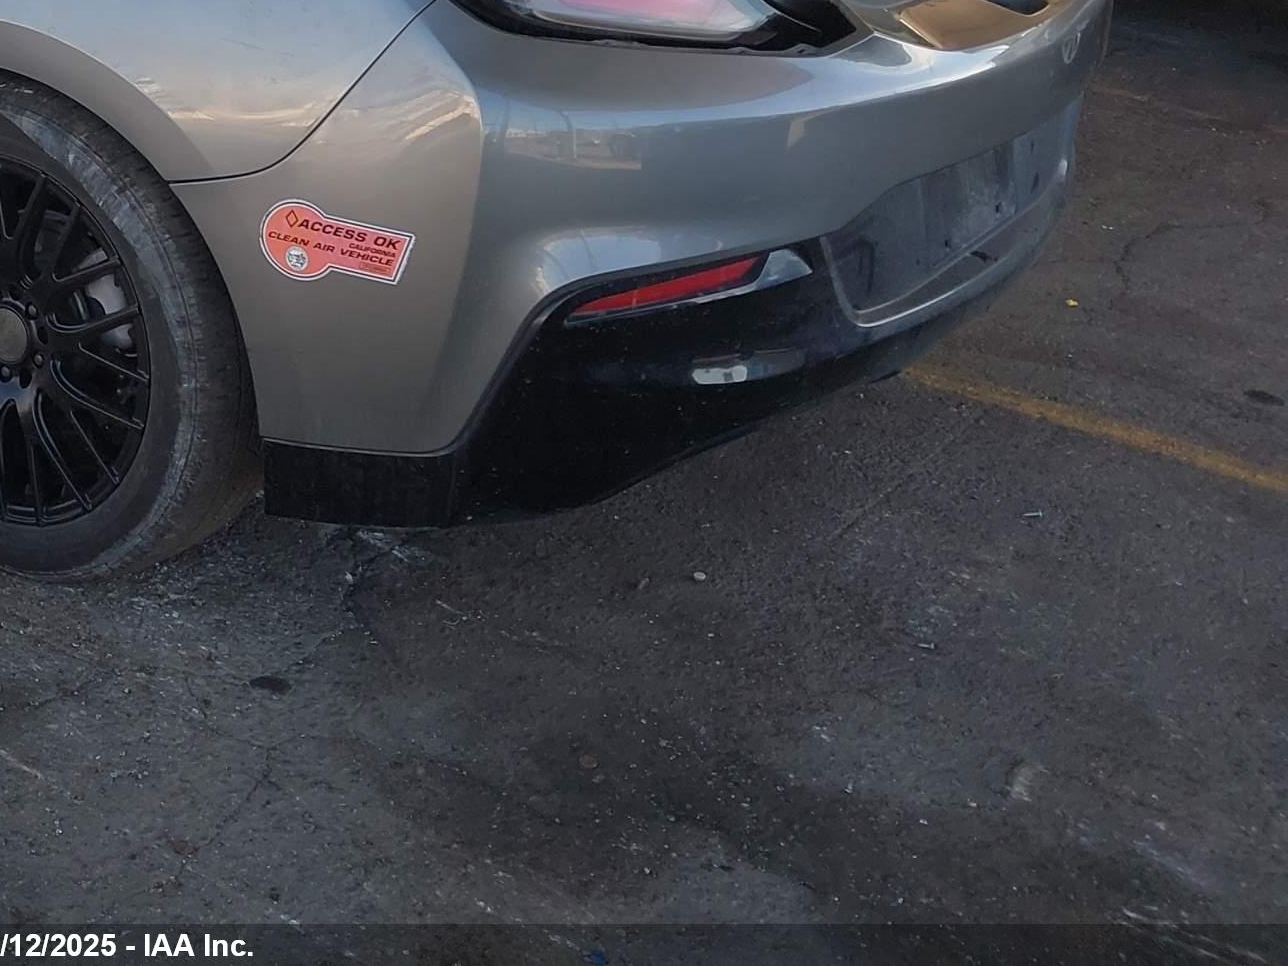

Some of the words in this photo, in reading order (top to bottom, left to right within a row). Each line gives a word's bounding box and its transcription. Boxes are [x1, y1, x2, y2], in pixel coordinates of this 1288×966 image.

[268, 231, 310, 246] CLEAN
[313, 242, 335, 253] AIR
[340, 248, 394, 266] VEHICLE
[298, 219, 367, 243] ACCESS
[373, 236, 401, 250] OK
[349, 242, 396, 258] CALIFORNIA
